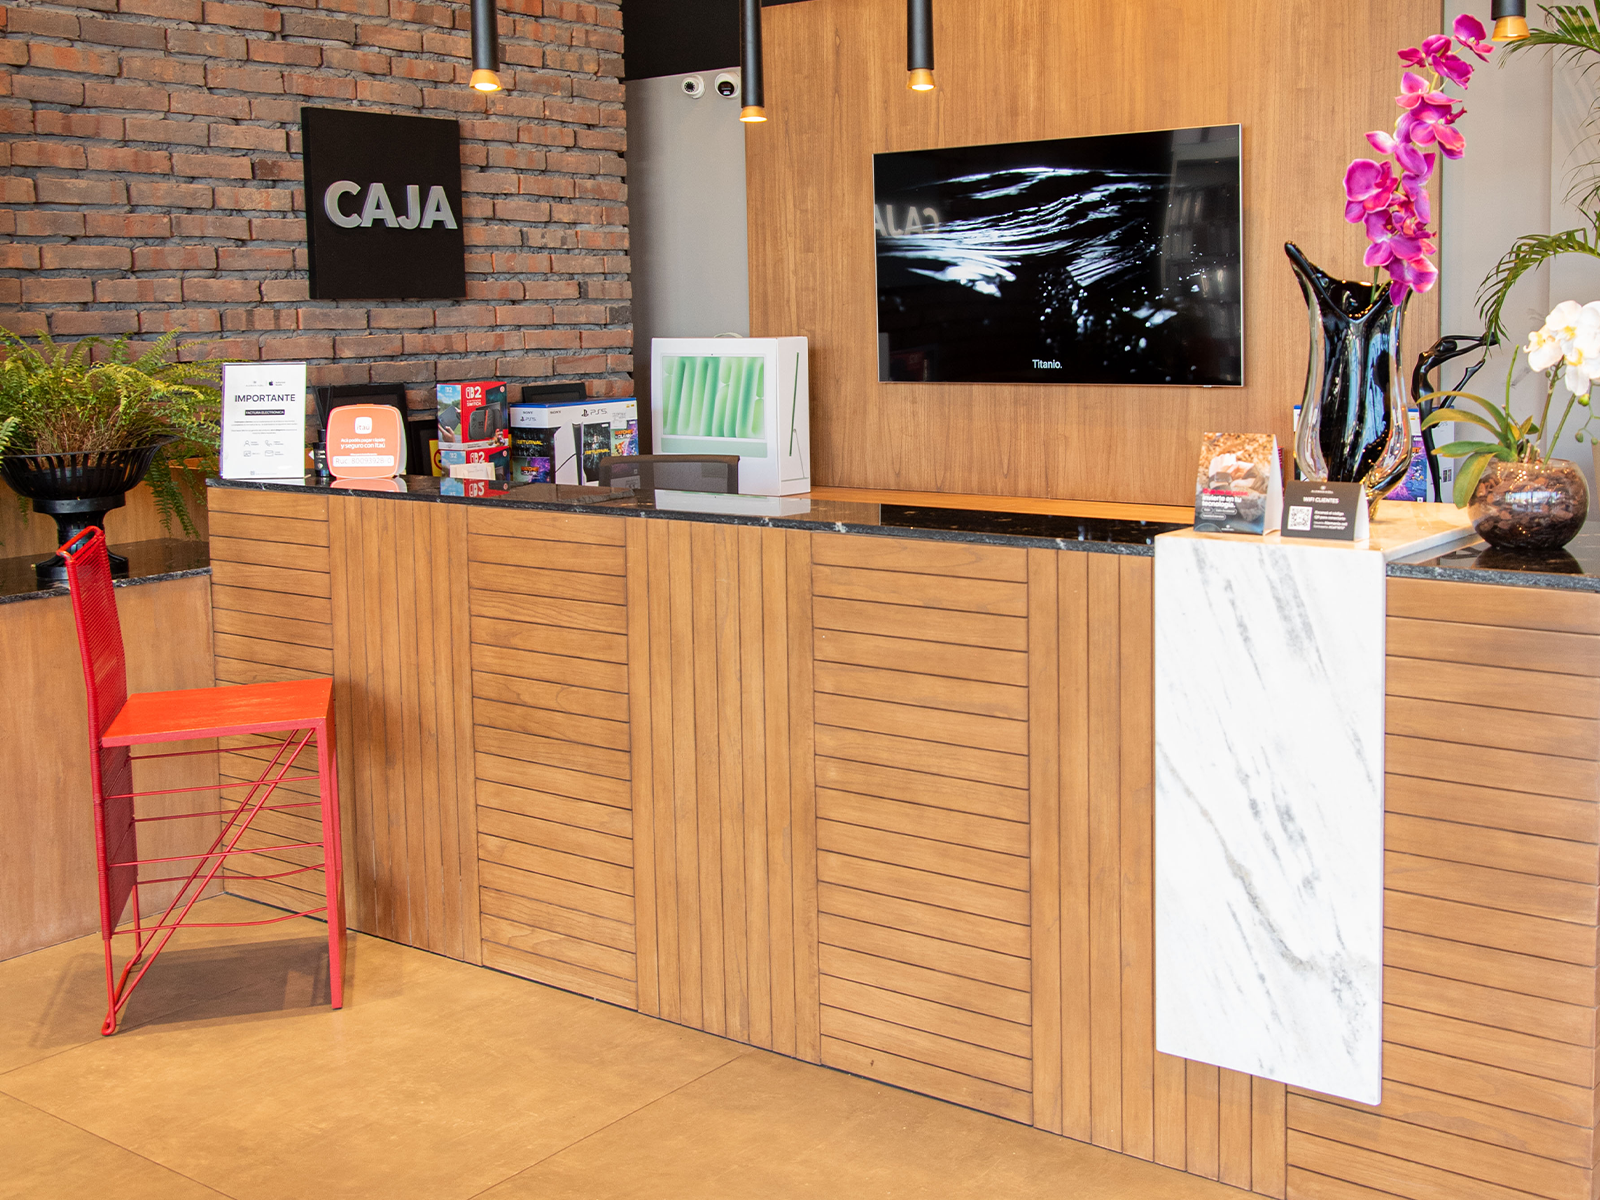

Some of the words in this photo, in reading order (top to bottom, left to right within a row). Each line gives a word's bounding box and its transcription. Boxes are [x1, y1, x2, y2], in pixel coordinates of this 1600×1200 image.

[324, 180, 458, 230] CAJA
[1032, 359, 1063, 369] Titanio.
[234, 394, 296, 402] IMPORTANTE
[590, 408, 608, 416] PS5
